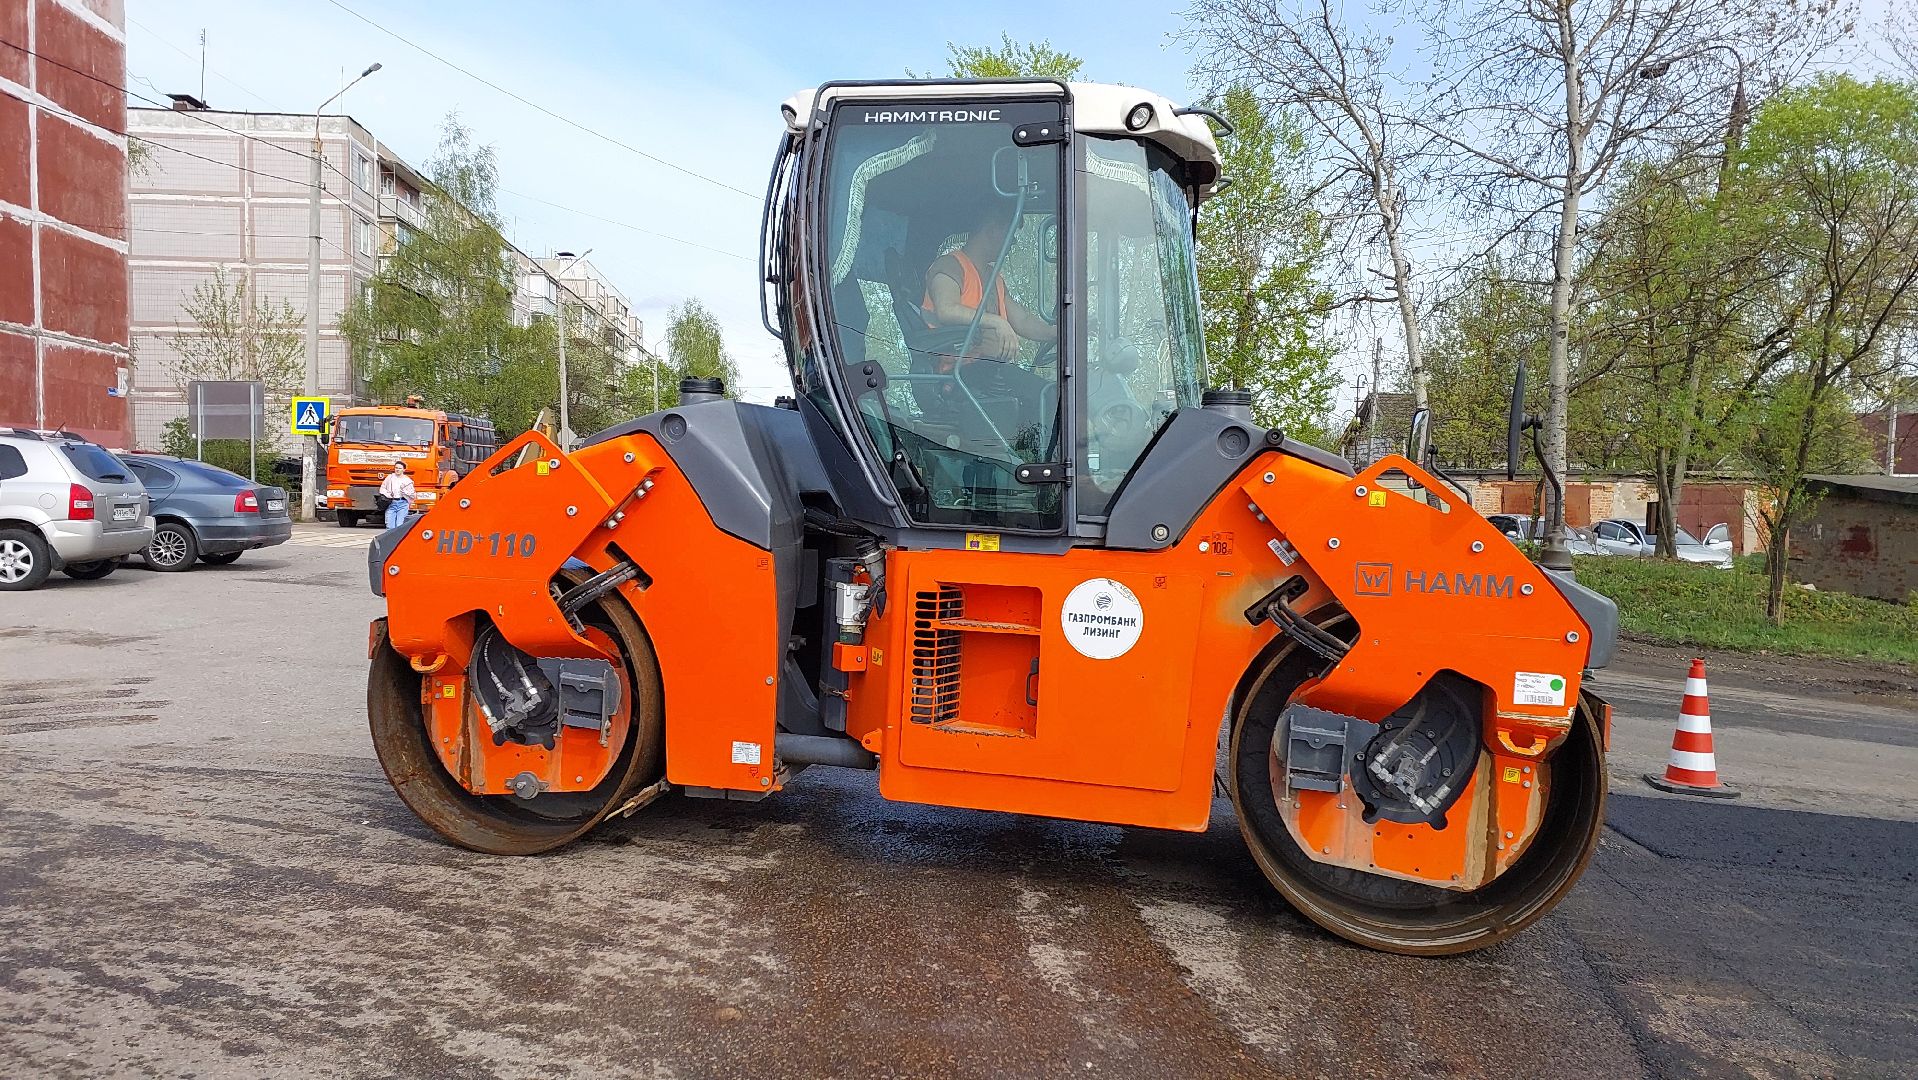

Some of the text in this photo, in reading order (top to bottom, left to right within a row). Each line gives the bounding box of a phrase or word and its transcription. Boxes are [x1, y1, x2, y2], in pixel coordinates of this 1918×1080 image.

[864, 109, 1001, 123] HAMMTRONIC
[488, 532, 537, 558] 110
[1212, 541, 1228, 554] 108
[1405, 569, 1515, 599] HAMM
[1068, 612, 1137, 628] ГАЗПРОМБАНК
[1083, 626, 1121, 639] ЛИЗИНГ
